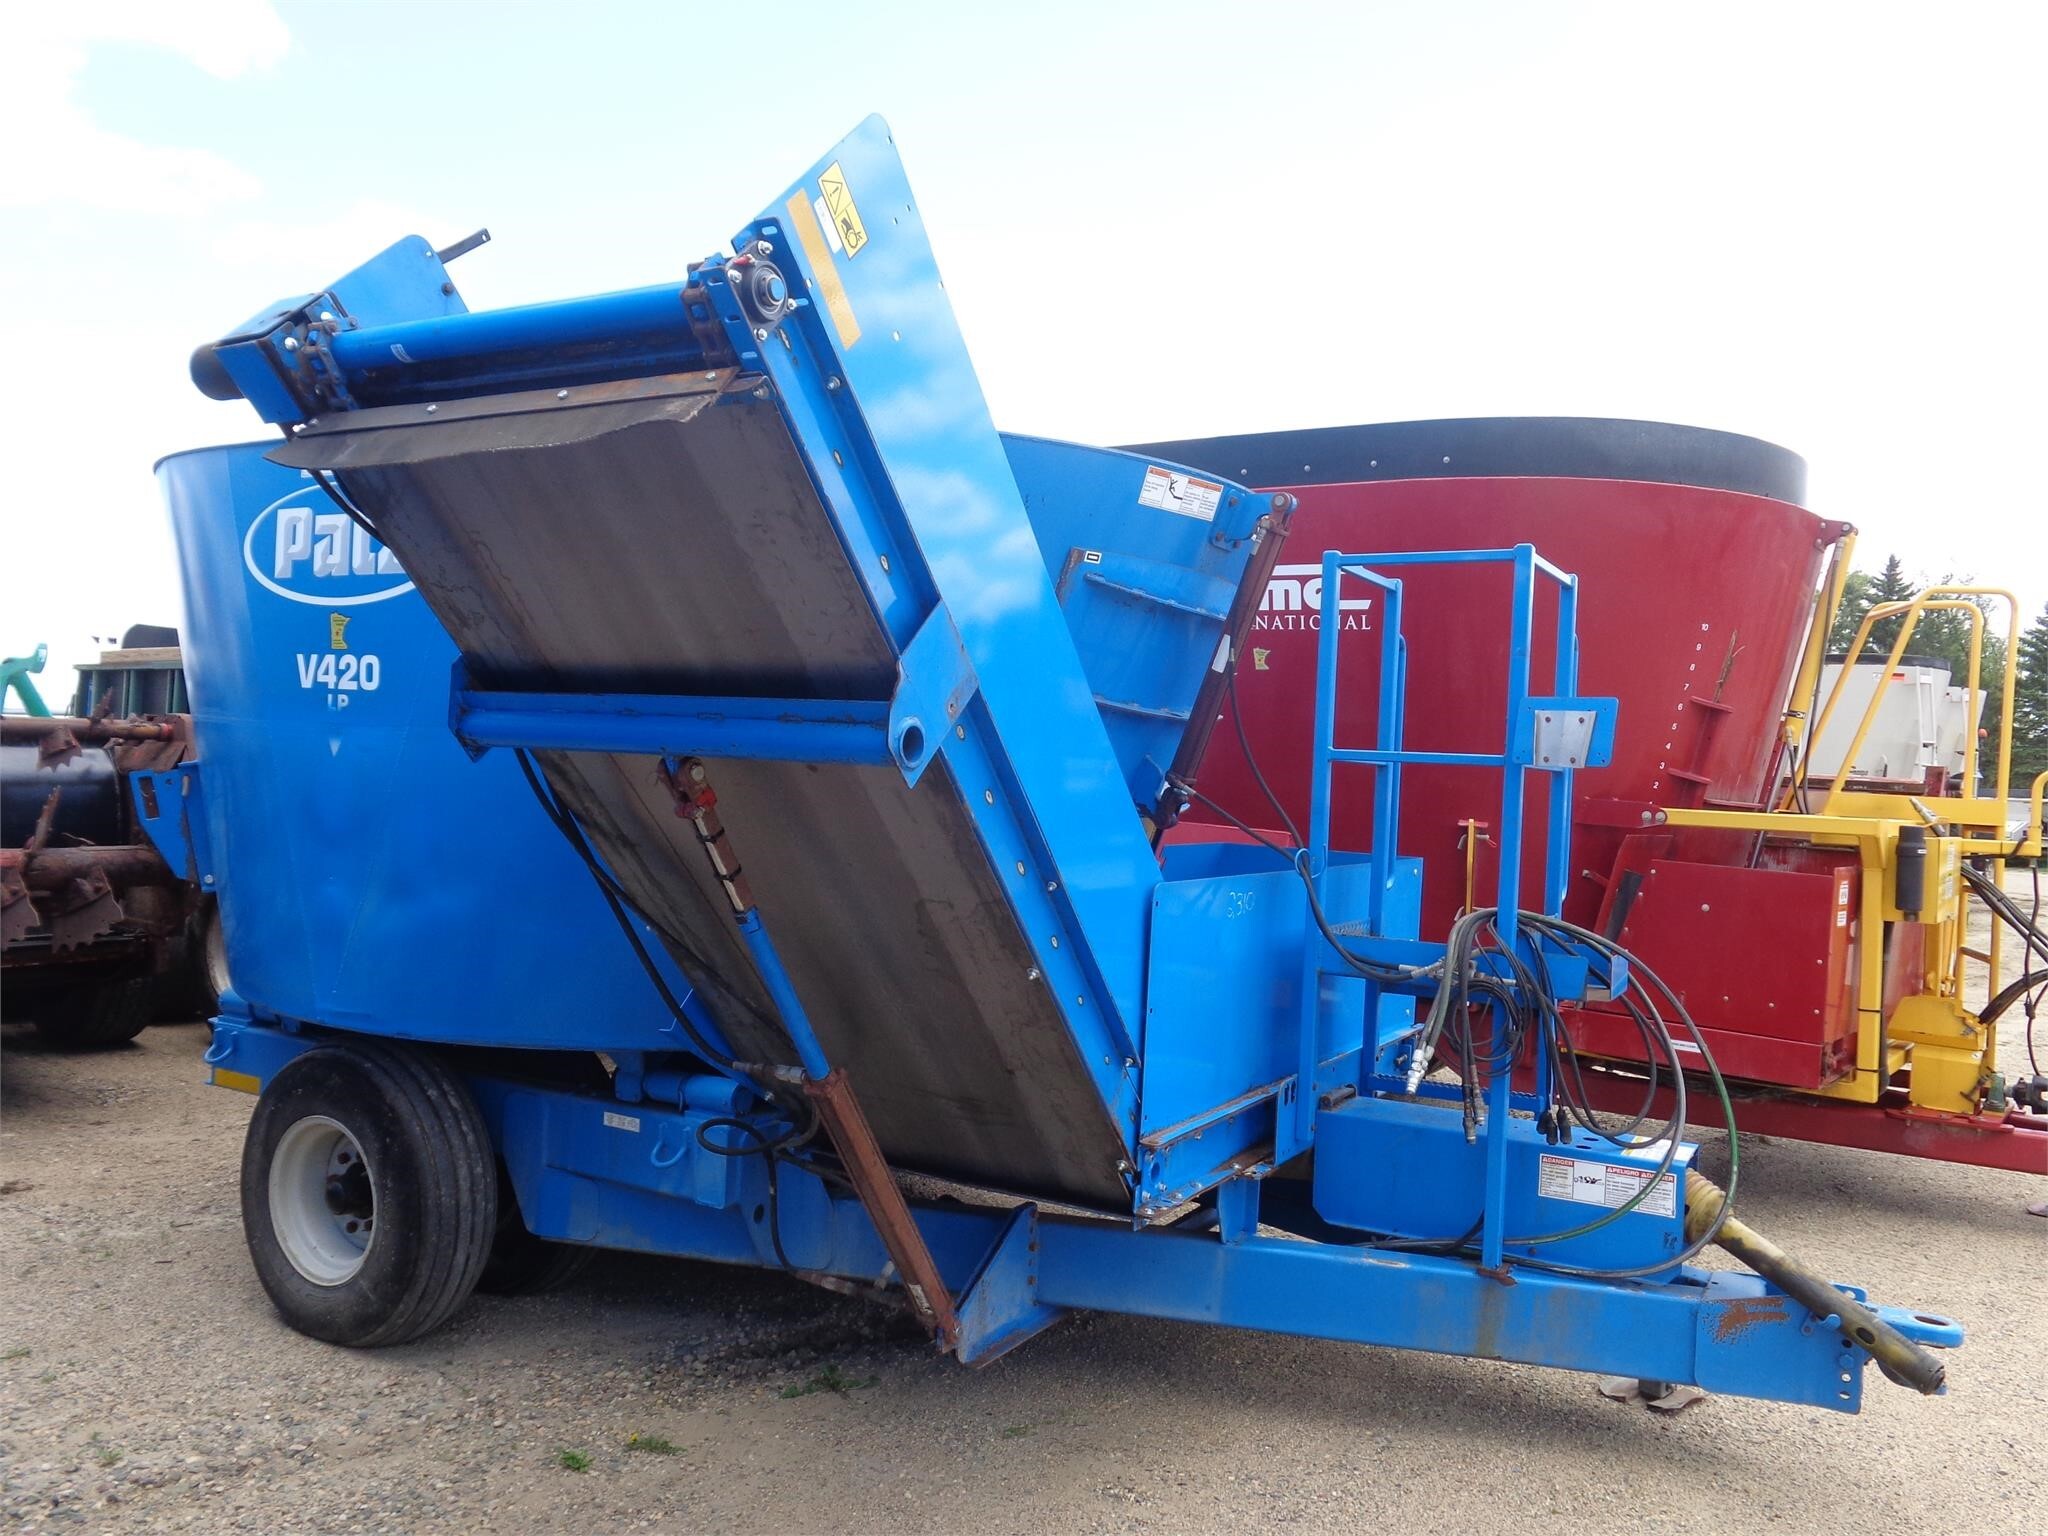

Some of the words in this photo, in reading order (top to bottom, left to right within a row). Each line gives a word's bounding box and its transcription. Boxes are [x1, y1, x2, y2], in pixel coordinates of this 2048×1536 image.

[296, 653, 381, 690] V420
[1684, 683, 1690, 691] 7
[327, 693, 350, 711] LP
